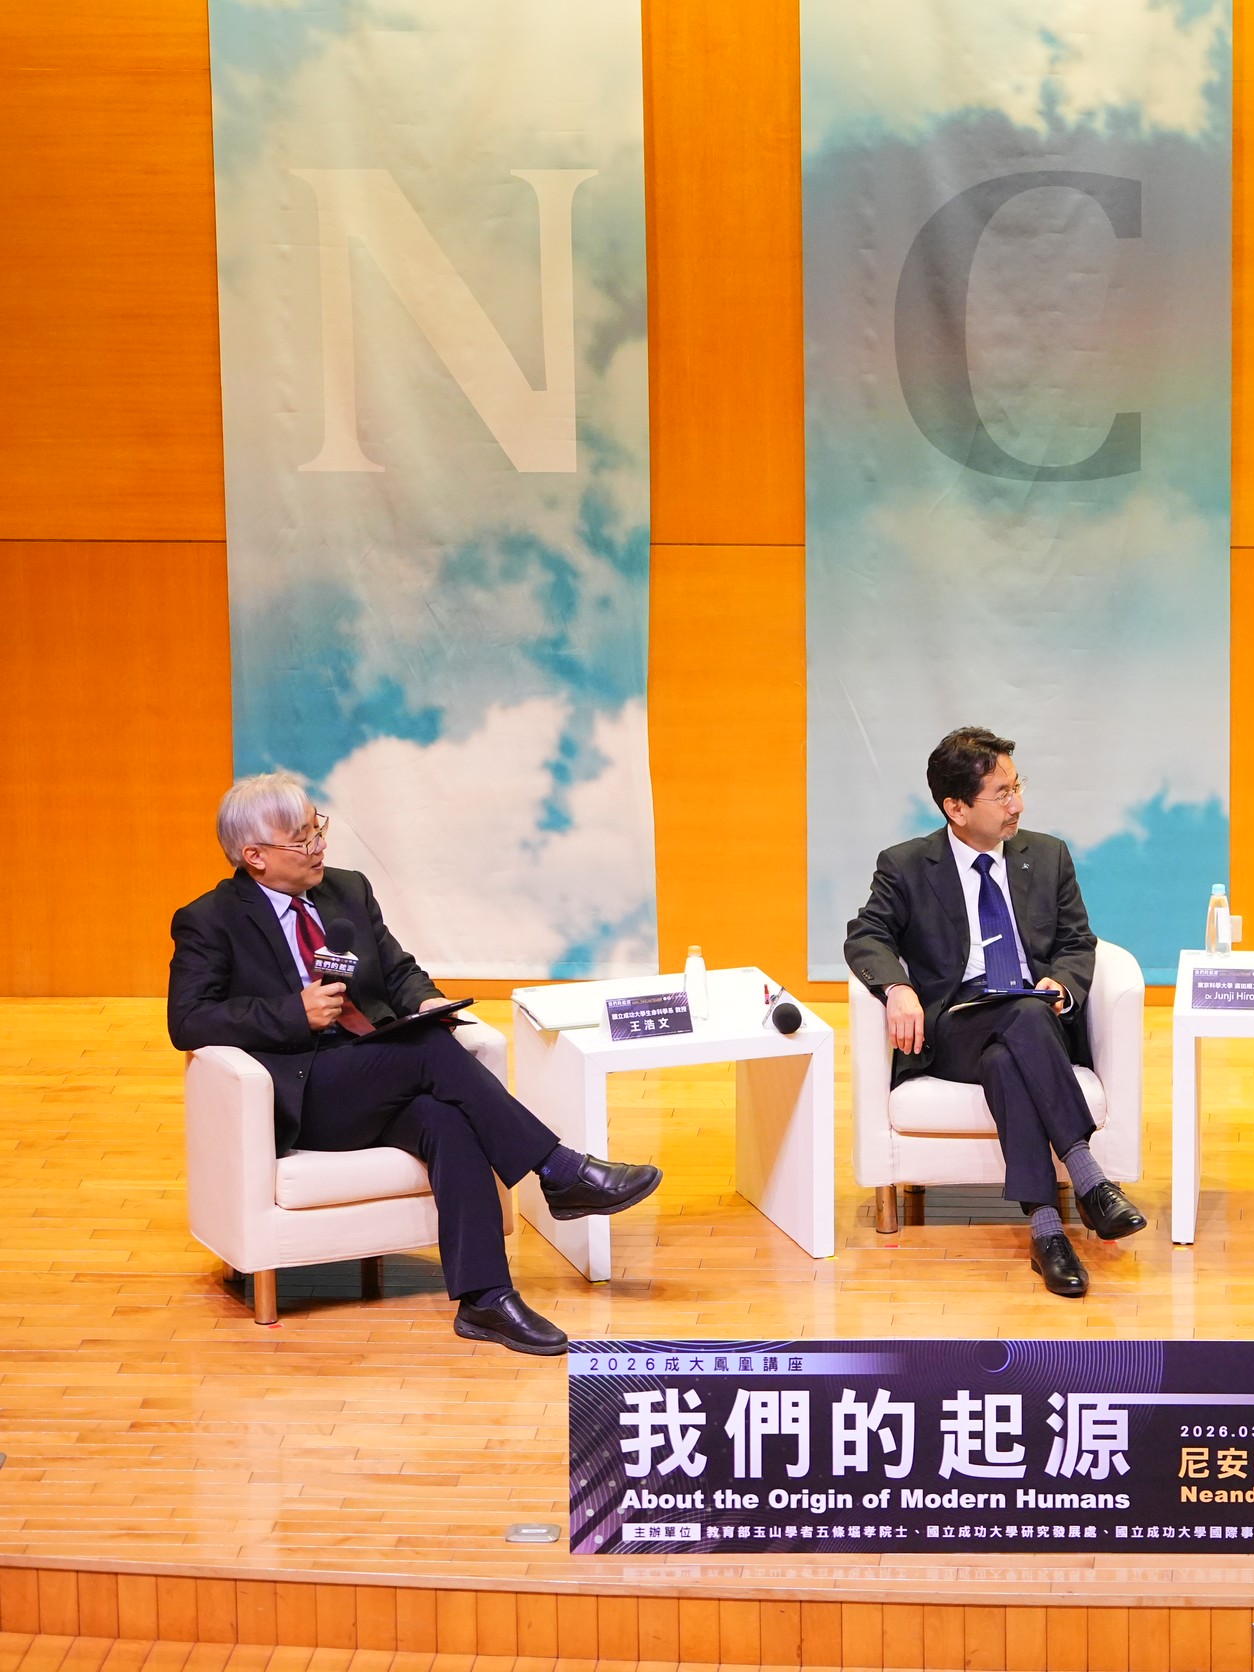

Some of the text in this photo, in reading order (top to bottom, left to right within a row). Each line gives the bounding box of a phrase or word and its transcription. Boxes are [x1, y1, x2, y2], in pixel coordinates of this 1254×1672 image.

[289, 168, 599, 474] N
[894, 170, 1142, 482] C
[1214, 992, 1234, 1002] Junji
[630, 1018, 669, 1032] 王浩文
[589, 1356, 804, 1373] 2026成大鳳凰講座
[619, 1387, 1131, 1480] 我們的起源
[621, 1488, 1131, 1514] About the Origin of Modern Humans
[634, 1526, 693, 1539] 主辦單位
